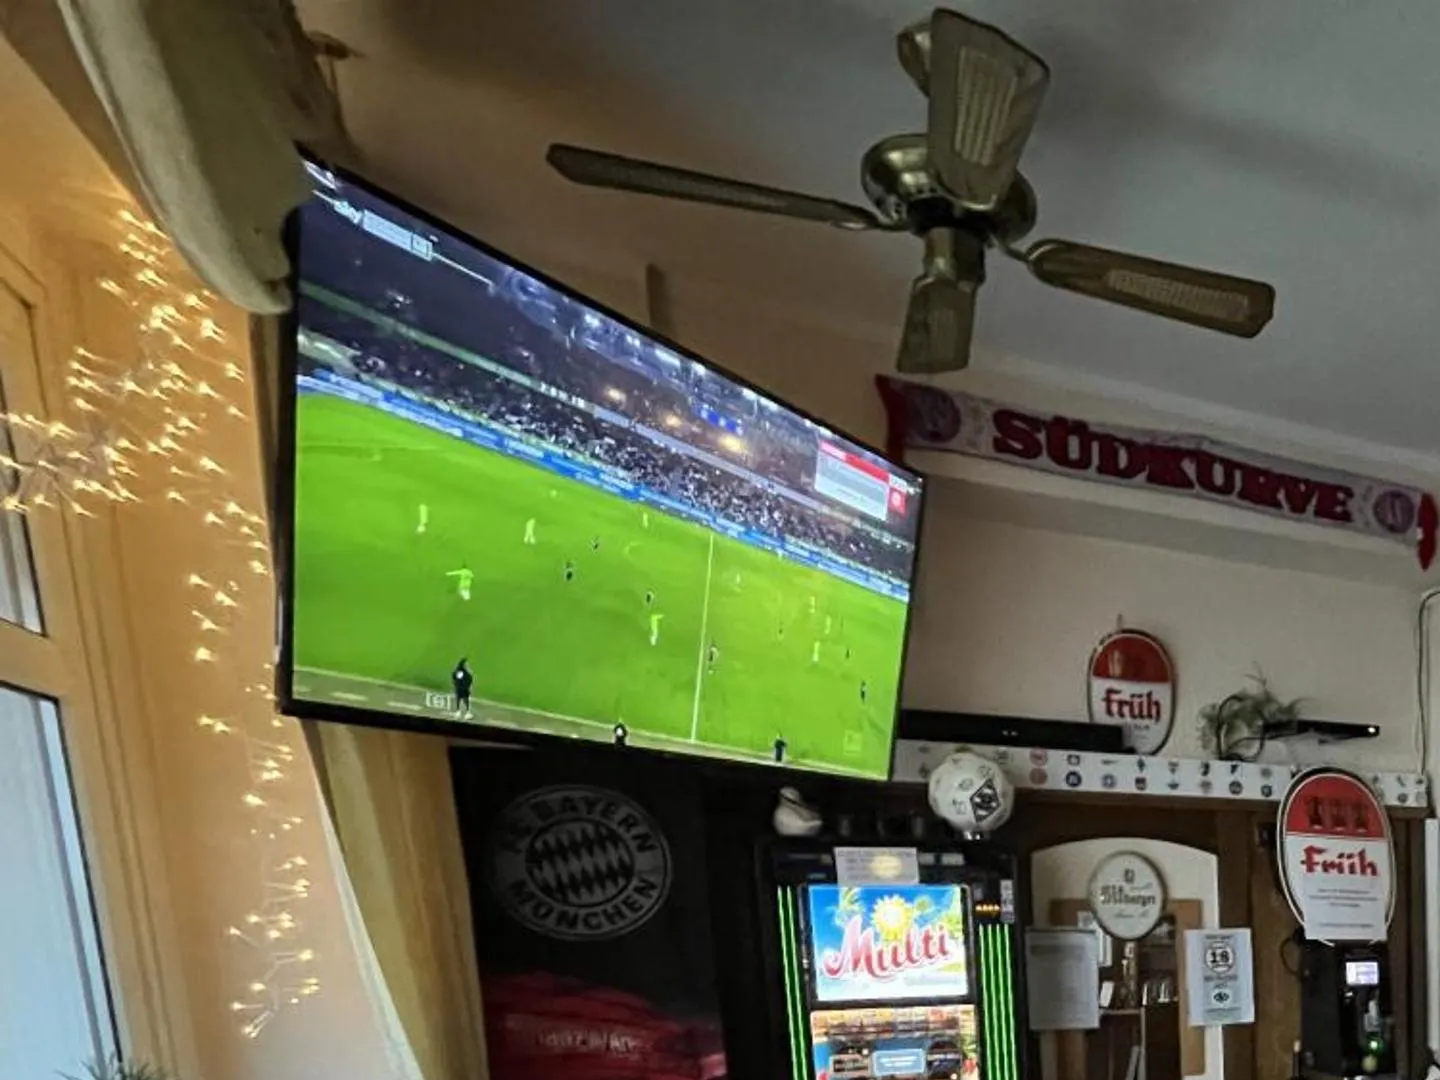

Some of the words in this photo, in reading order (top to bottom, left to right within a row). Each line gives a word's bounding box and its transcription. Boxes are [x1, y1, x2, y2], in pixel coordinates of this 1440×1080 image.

[993, 408, 1353, 522] SÜDKURVE
[1101, 687, 1161, 723] Früh
[530, 796, 658, 853] BAYERN
[1300, 845, 1378, 876] Früh
[825, 914, 951, 980] Multi
[1210, 950, 1230, 964] 18
